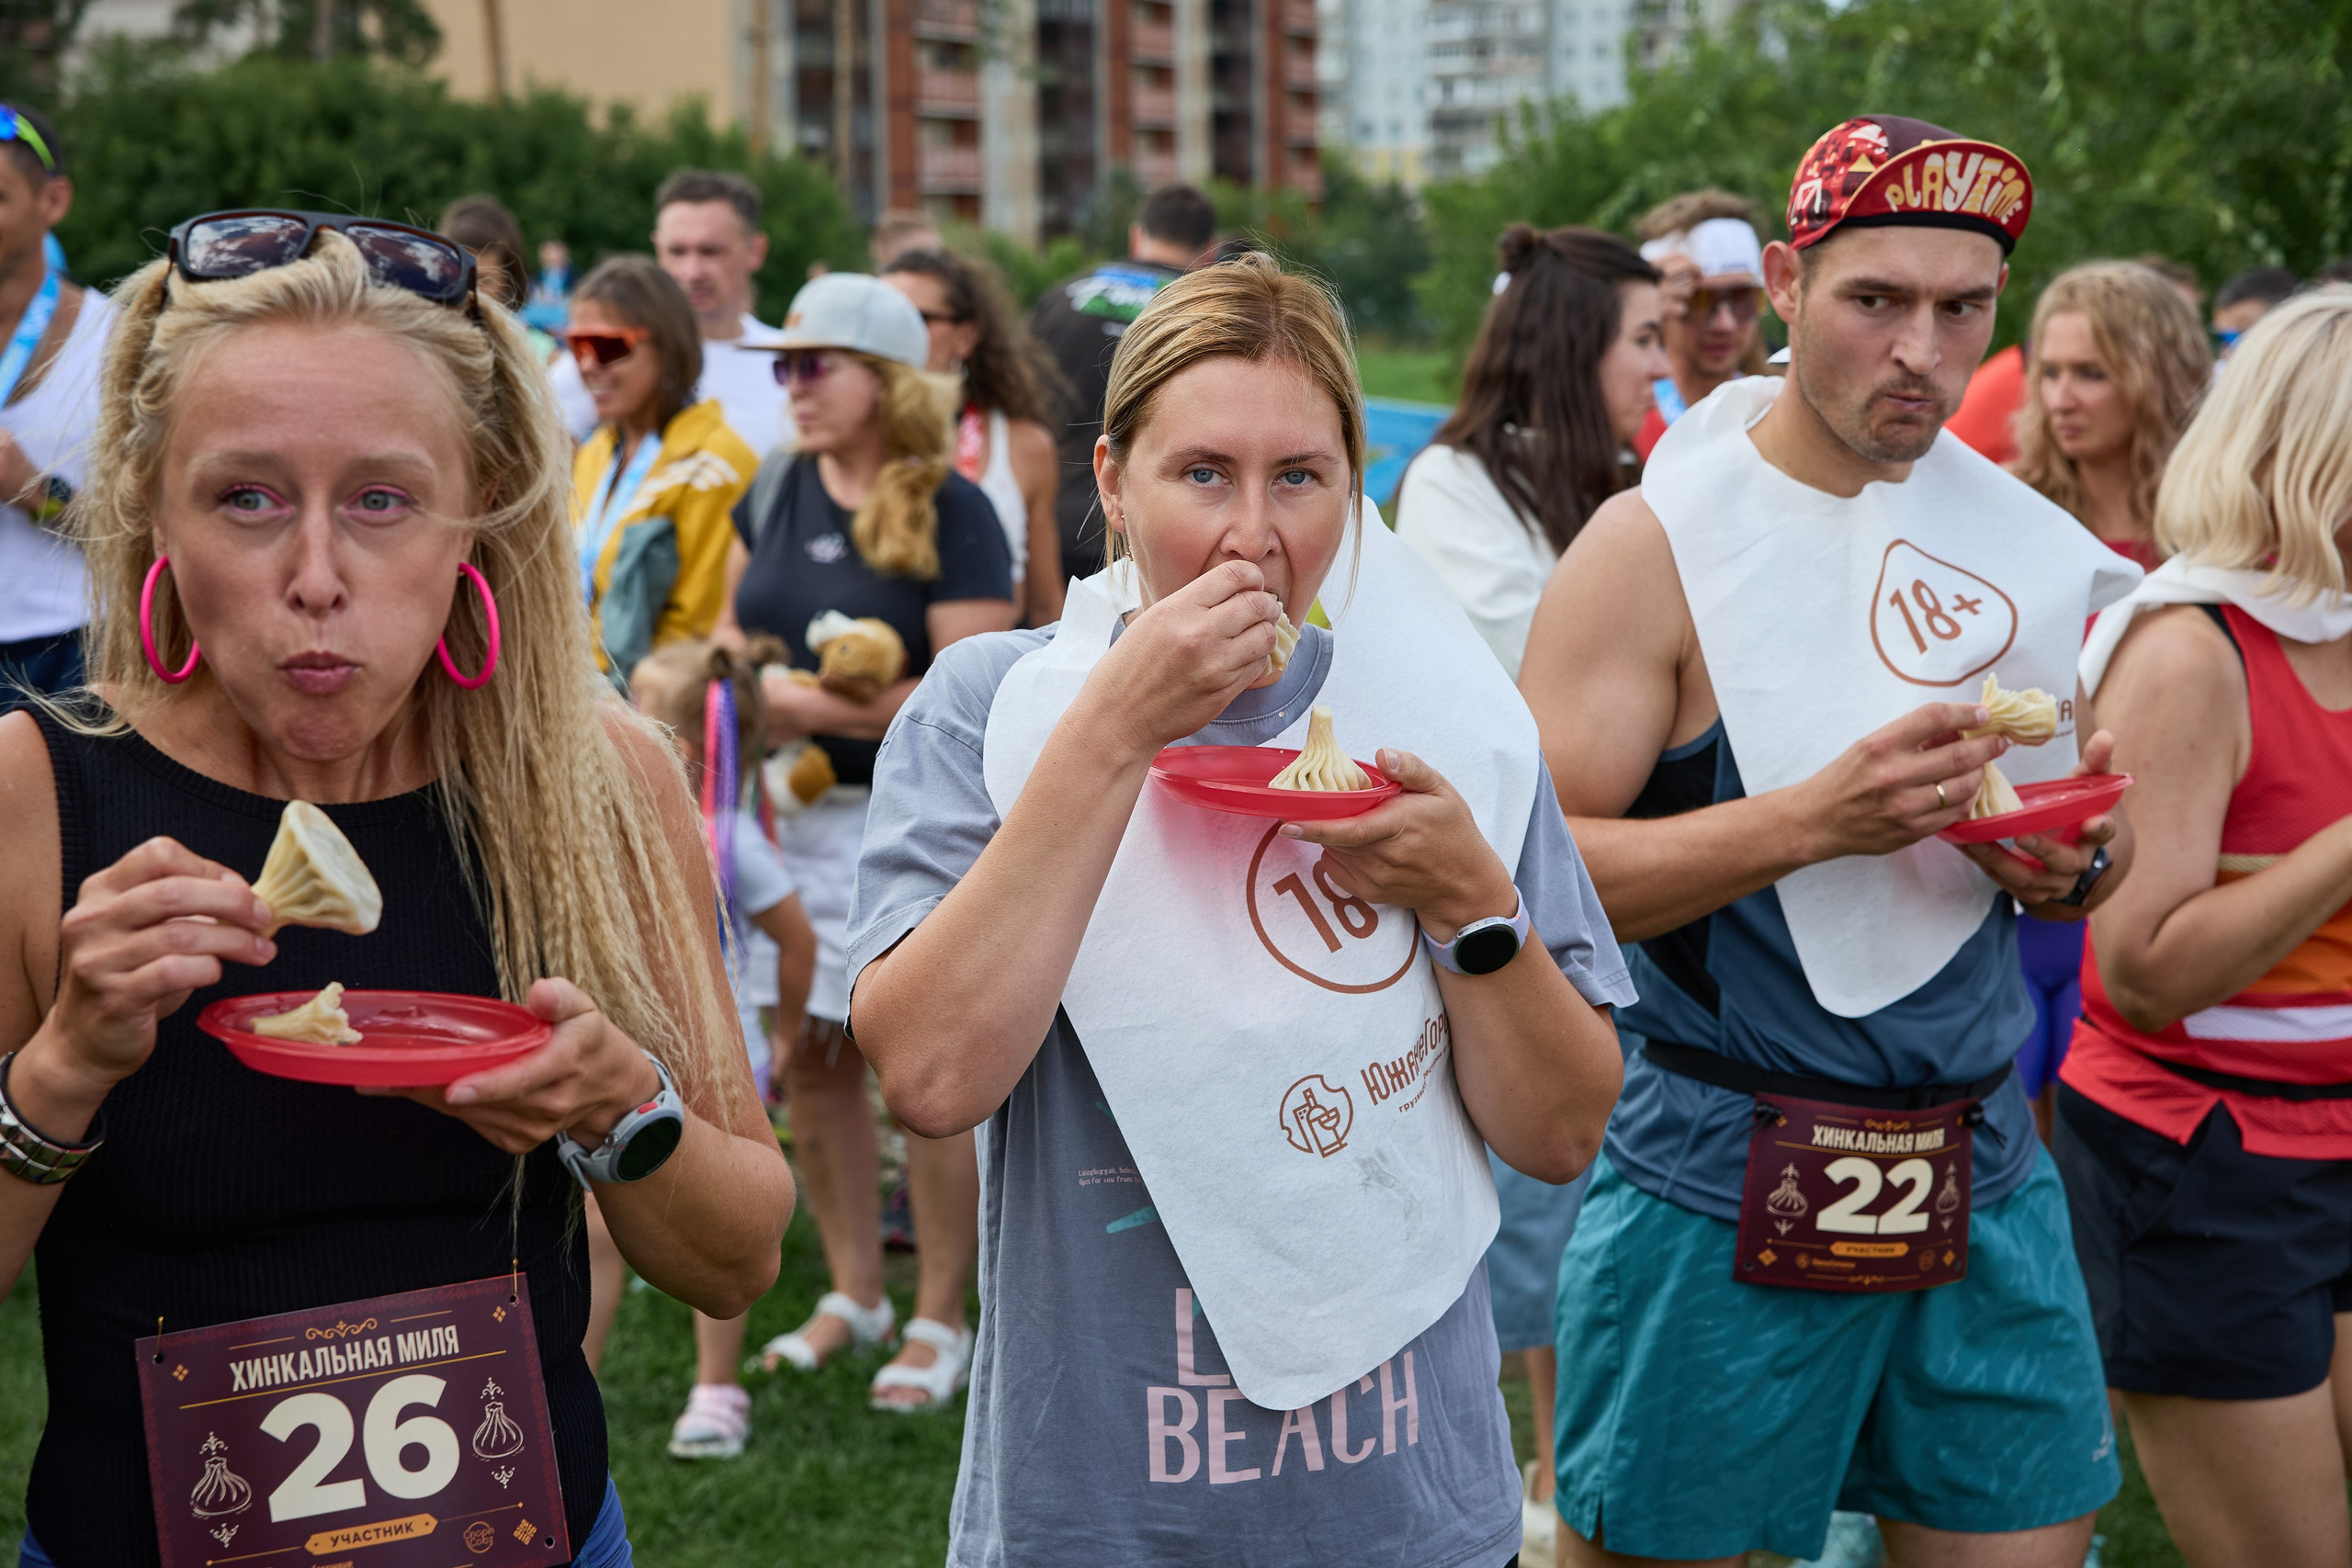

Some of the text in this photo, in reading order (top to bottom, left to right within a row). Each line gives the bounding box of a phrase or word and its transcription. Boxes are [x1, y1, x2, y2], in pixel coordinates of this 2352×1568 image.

[1889, 579, 1983, 654] 18+
[1272, 849, 1379, 953] 18
[1811, 1124, 1945, 1154] ХИНКАЛЬНАЯ МИЛЯ
[1815, 1156, 1934, 1235] 22
[229, 1325, 459, 1392] ХИНКАЛЬНАЯ МИЛЯ
[259, 1374, 460, 1523] 26
[1148, 1350, 1419, 1484] BEACH
[330, 1521, 414, 1547] УЧАСТНИК
